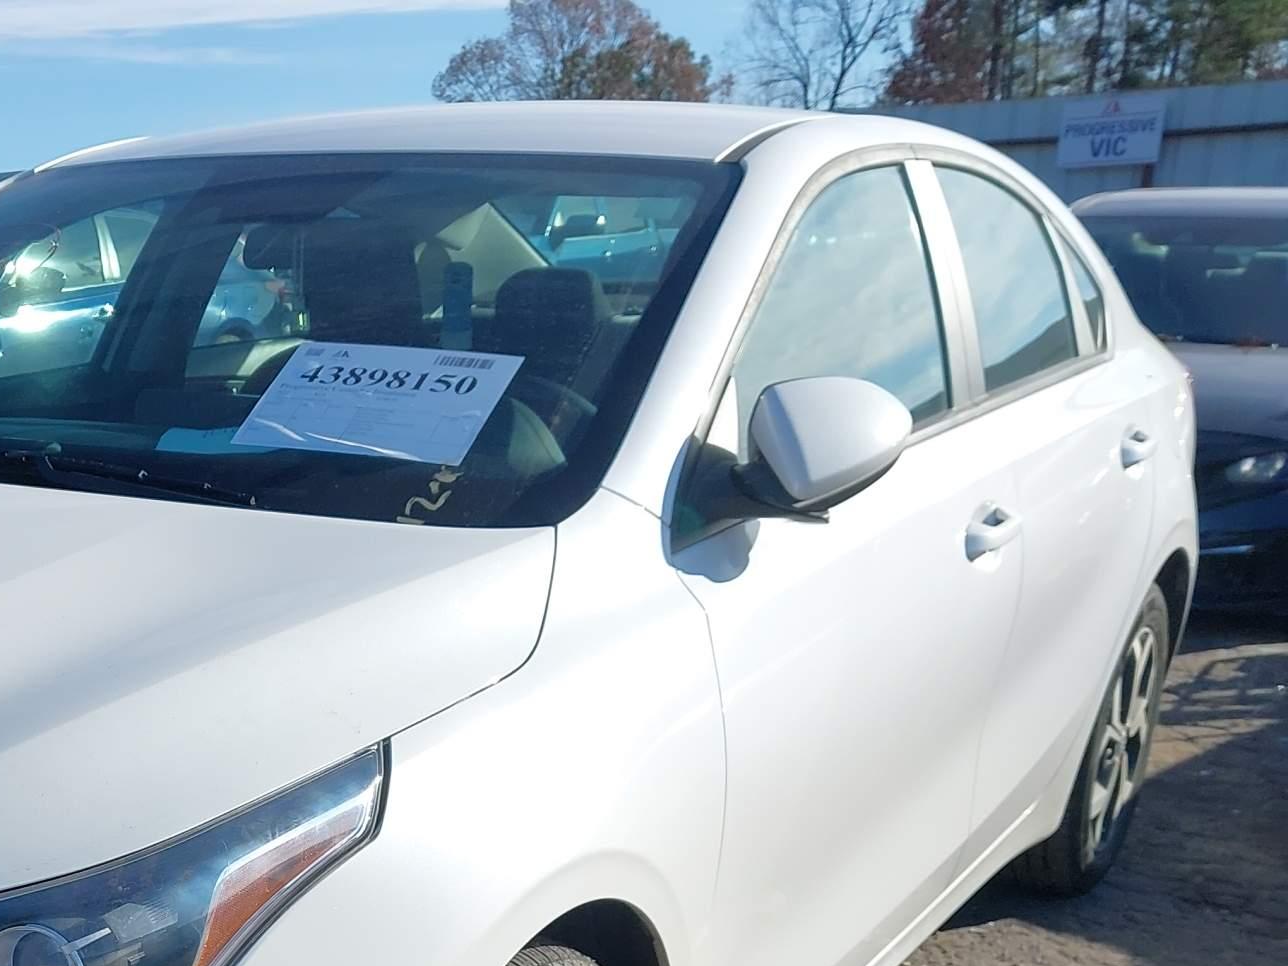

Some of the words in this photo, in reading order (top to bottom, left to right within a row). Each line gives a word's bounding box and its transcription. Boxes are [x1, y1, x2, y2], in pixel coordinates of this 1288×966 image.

[1064, 117, 1156, 138] PROGRESSIVE
[1090, 136, 1128, 158] VIC
[299, 364, 479, 396] 43898150
